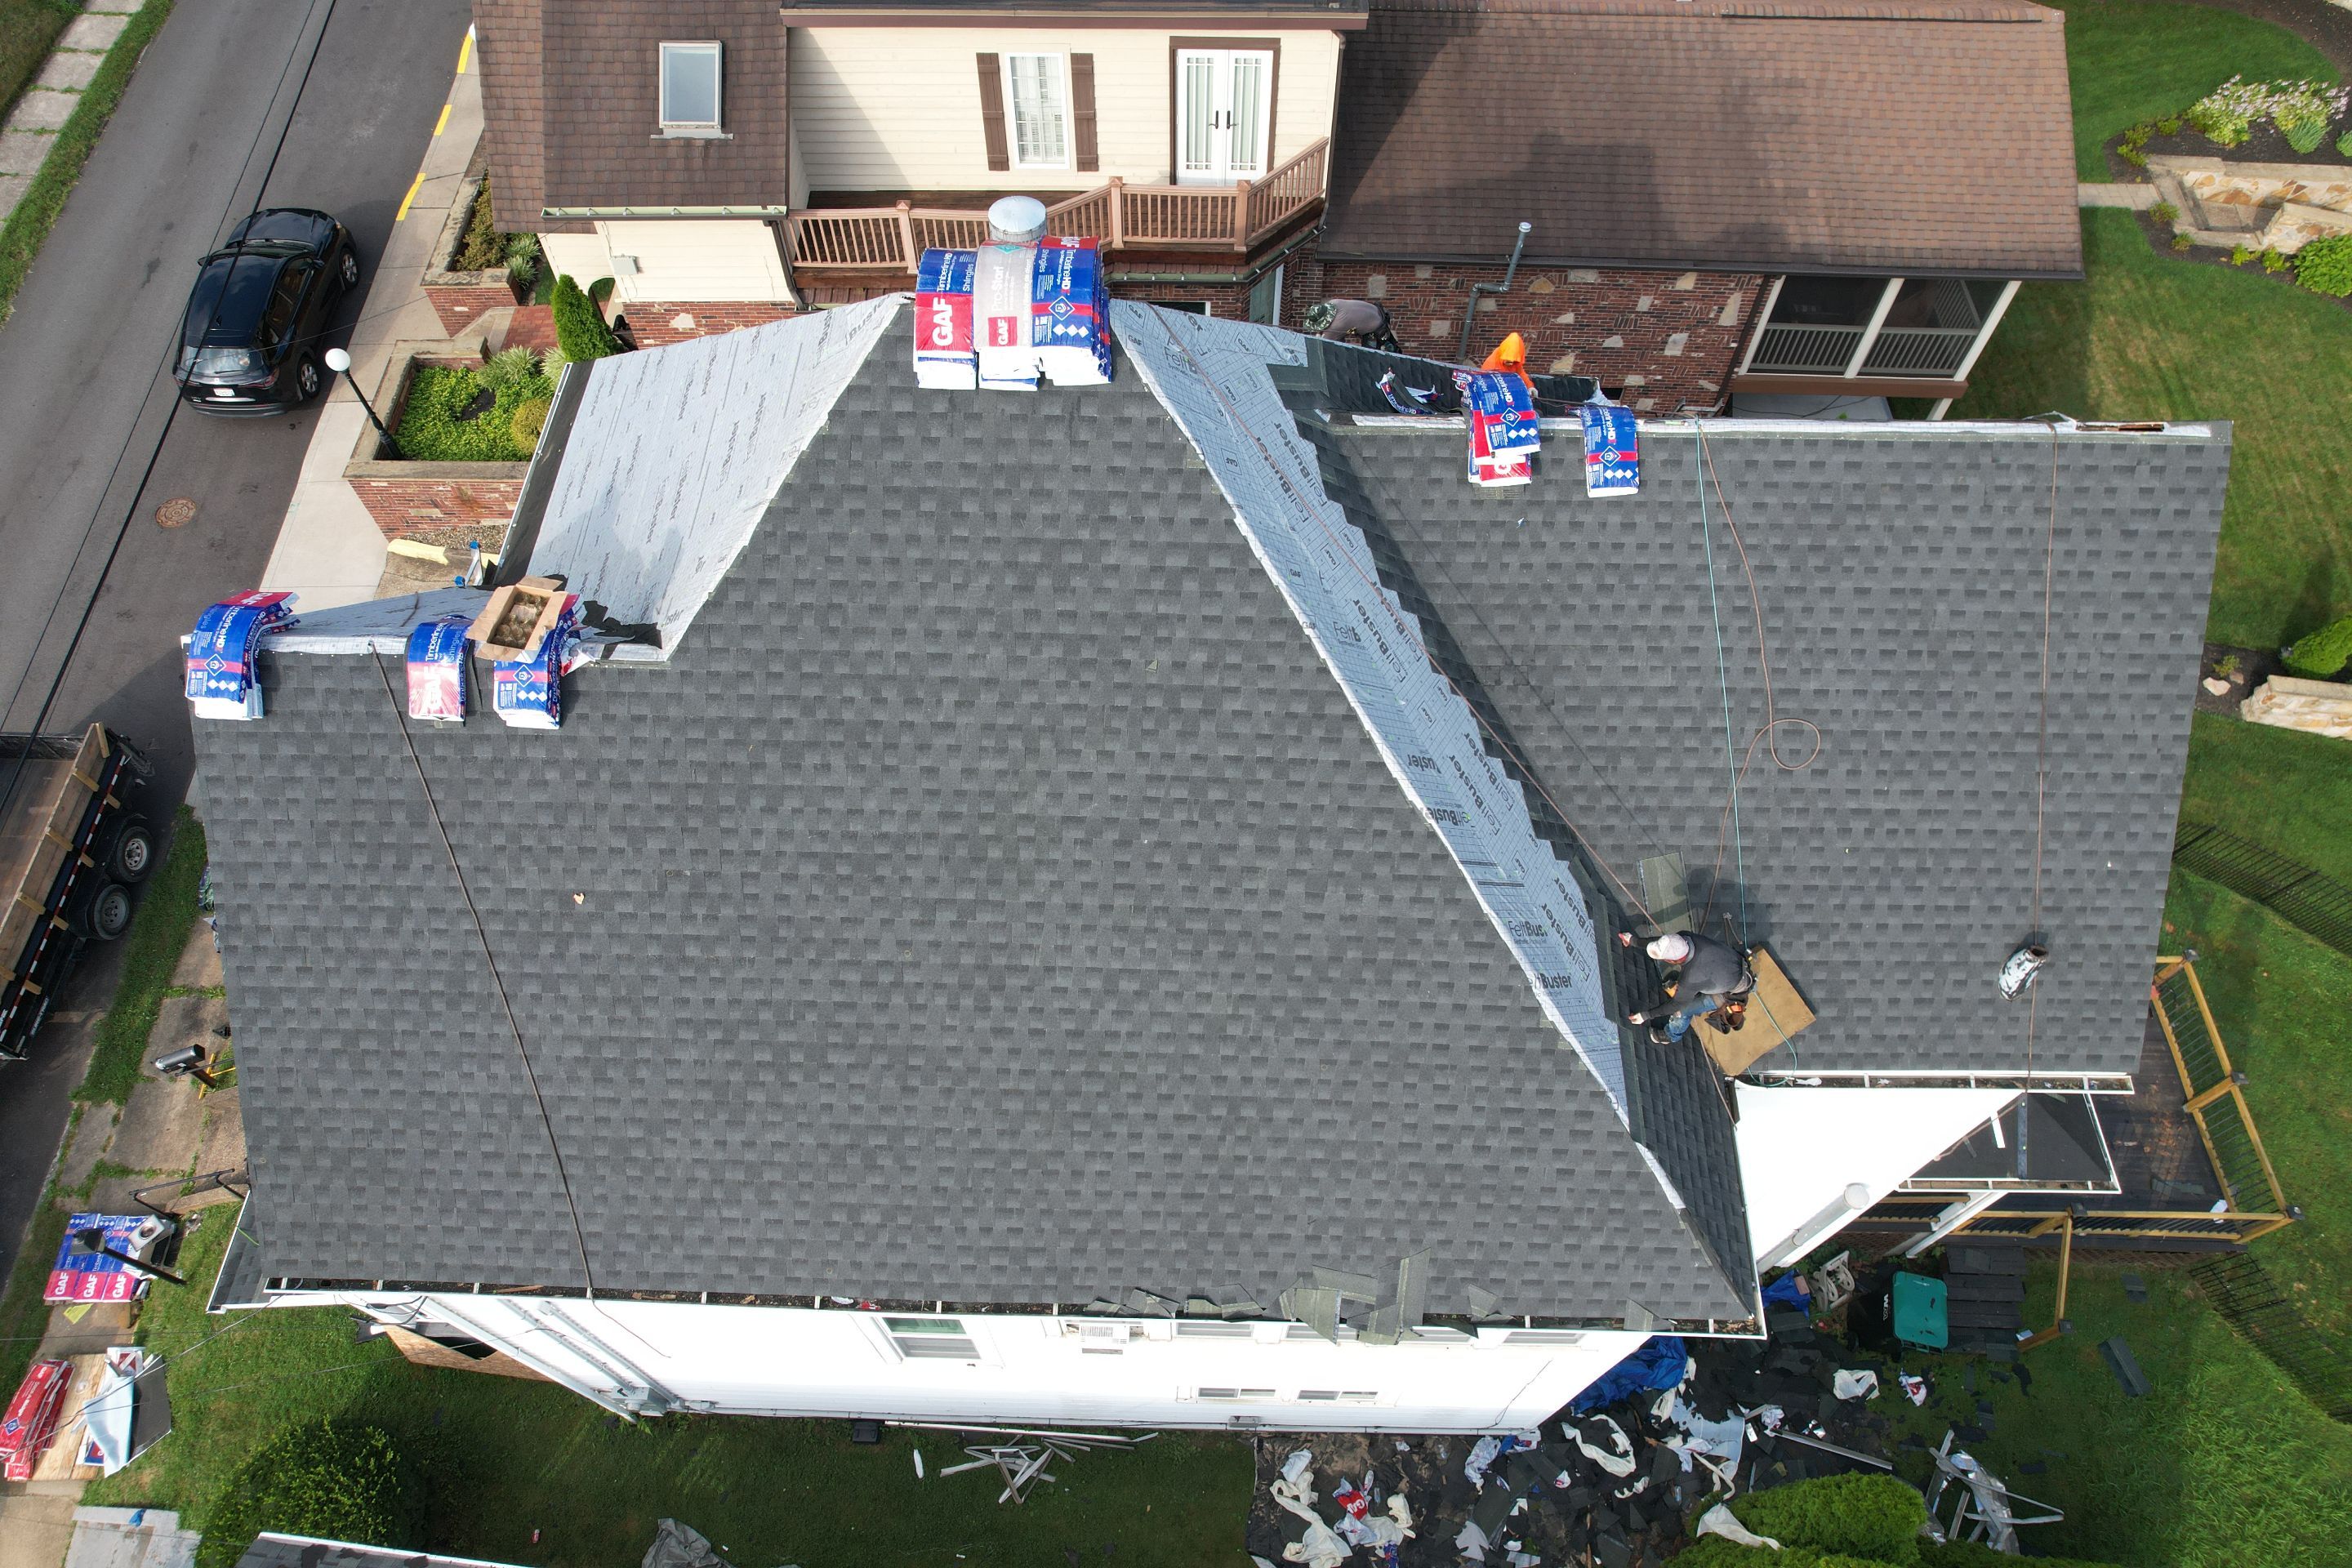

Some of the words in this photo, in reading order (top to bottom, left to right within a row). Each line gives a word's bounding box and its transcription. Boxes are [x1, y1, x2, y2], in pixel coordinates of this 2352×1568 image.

[963, 264, 974, 292] Shingles
[932, 297, 954, 346] GAF
[1129, 305, 1143, 319] GAF
[998, 318, 1009, 345] GAF
[1128, 335, 1143, 346] GAF
[1245, 372, 1258, 388] GAF
[1224, 385, 1236, 401] GAF
[717, 421, 740, 491] FeltBuster
[1226, 457, 1238, 467] GAF
[1274, 422, 1328, 506] FeltBuster
[1257, 437, 1309, 523] FeltBuster
[1342, 532, 1354, 548] GAF
[1325, 549, 1336, 566] GAF
[1290, 568, 1301, 577] GAF
[1370, 581, 1423, 662] FeltBuster
[1352, 599, 1406, 683] FeltBuster
[1438, 686, 1448, 702] GAF
[1421, 706, 1432, 723] GAF
[1463, 732, 1514, 811] FeltBuster
[1449, 755, 1500, 836] FeltBuster
[1528, 834, 1539, 848] GAF
[1515, 858, 1526, 874] GAF
[1541, 902, 1591, 982] FeltBuster
[55, 1272, 69, 1295] GAF
[83, 1274, 98, 1298] GAF
[112, 1274, 127, 1298] GAF
